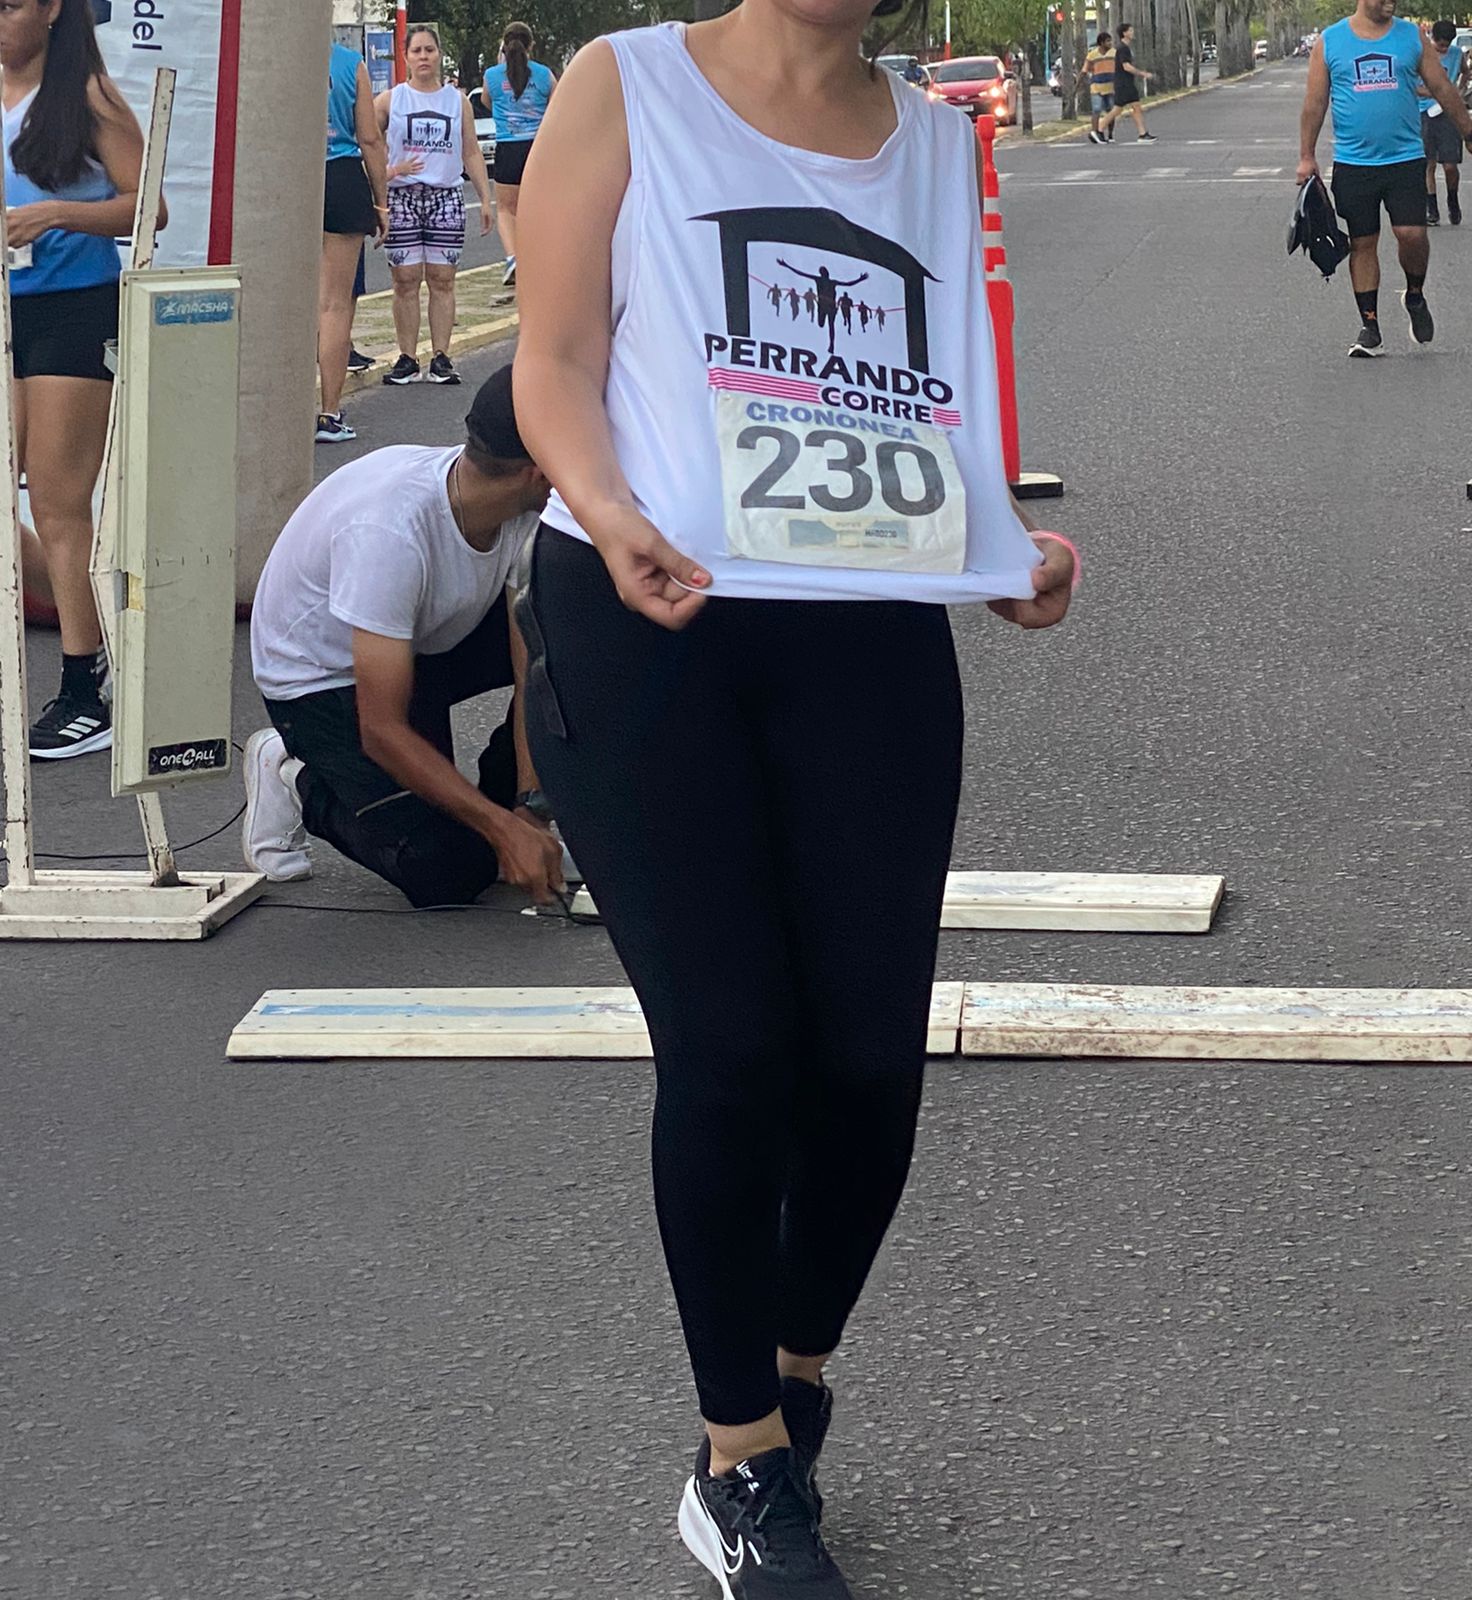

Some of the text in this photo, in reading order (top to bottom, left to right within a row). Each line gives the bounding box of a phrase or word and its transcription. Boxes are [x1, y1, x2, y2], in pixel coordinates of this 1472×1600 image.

[704, 333, 953, 404] PERRANDO
[746, 402, 920, 441] CRONONEA
[821, 386, 933, 424] CORRE
[736, 425, 946, 516] 230
